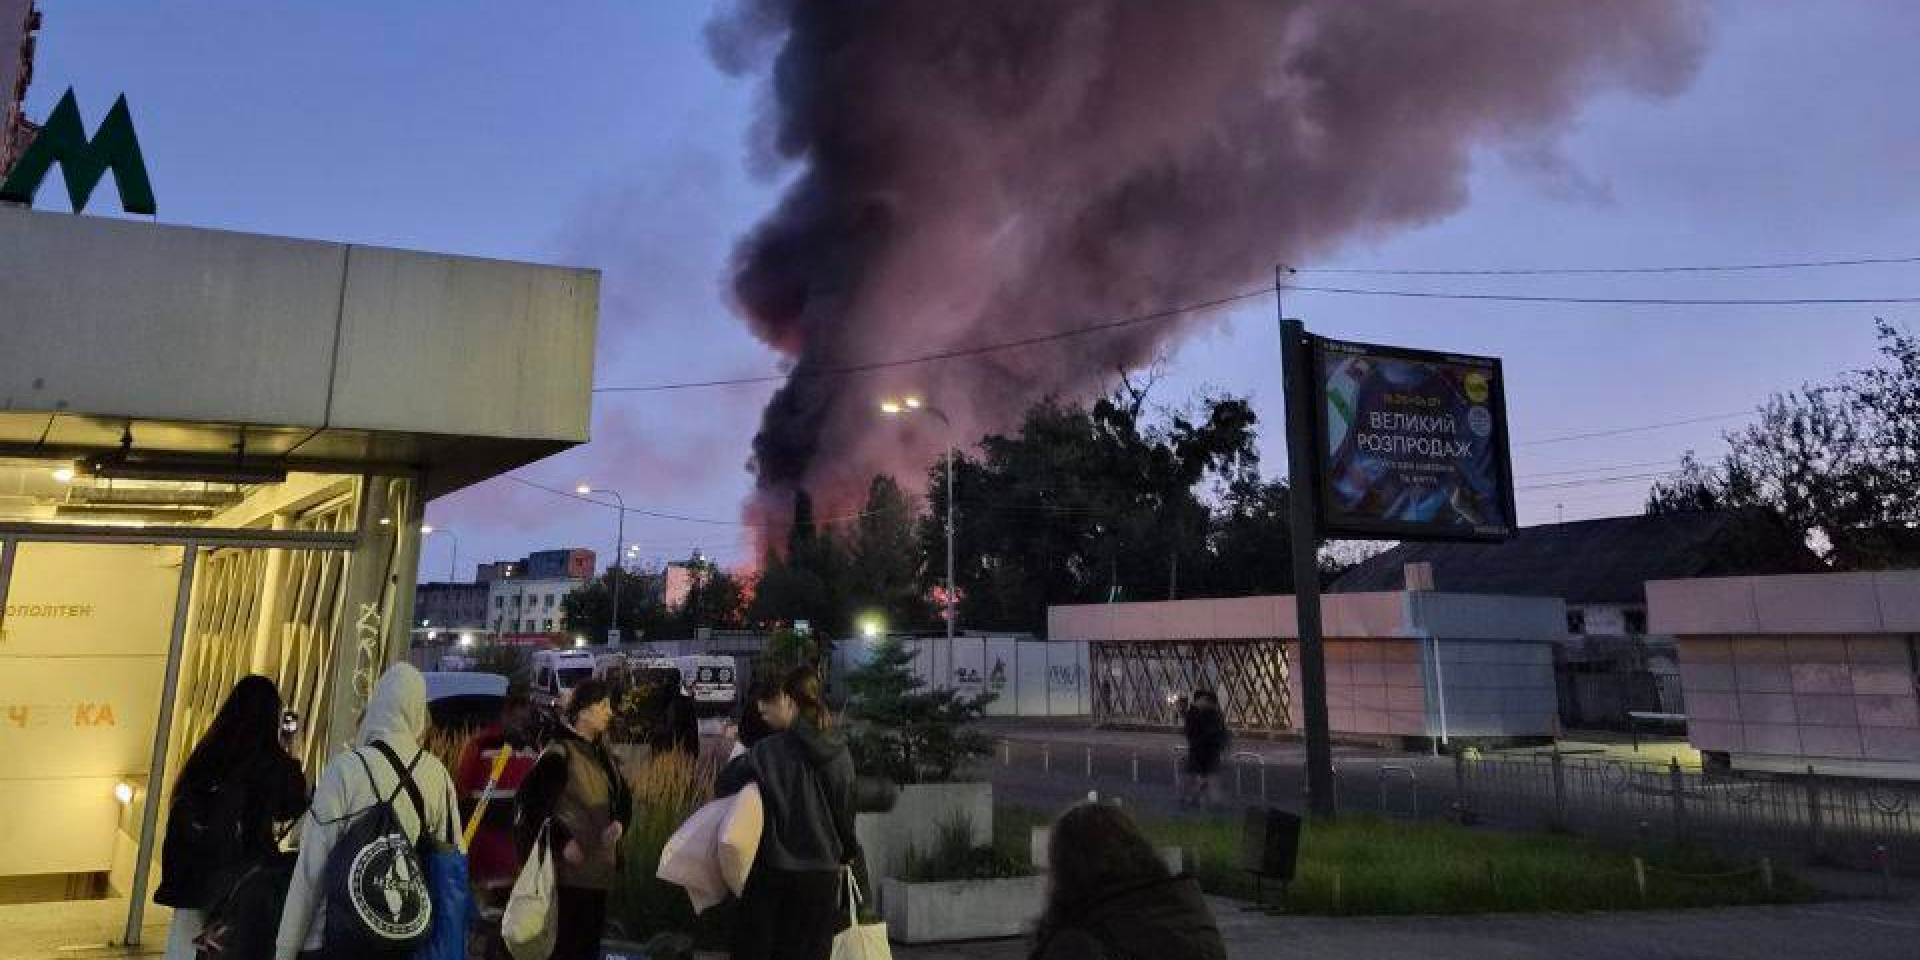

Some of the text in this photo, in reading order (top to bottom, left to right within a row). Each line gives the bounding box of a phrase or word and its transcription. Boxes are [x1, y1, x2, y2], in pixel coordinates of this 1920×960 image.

[0, 84, 157, 215] М
[1369, 411, 1456, 434] ВЕЛИКИЙ
[1358, 433, 1473, 457] РОЗПРОДАЖ
[6, 604, 93, 618] ОПОЛІТЕН
